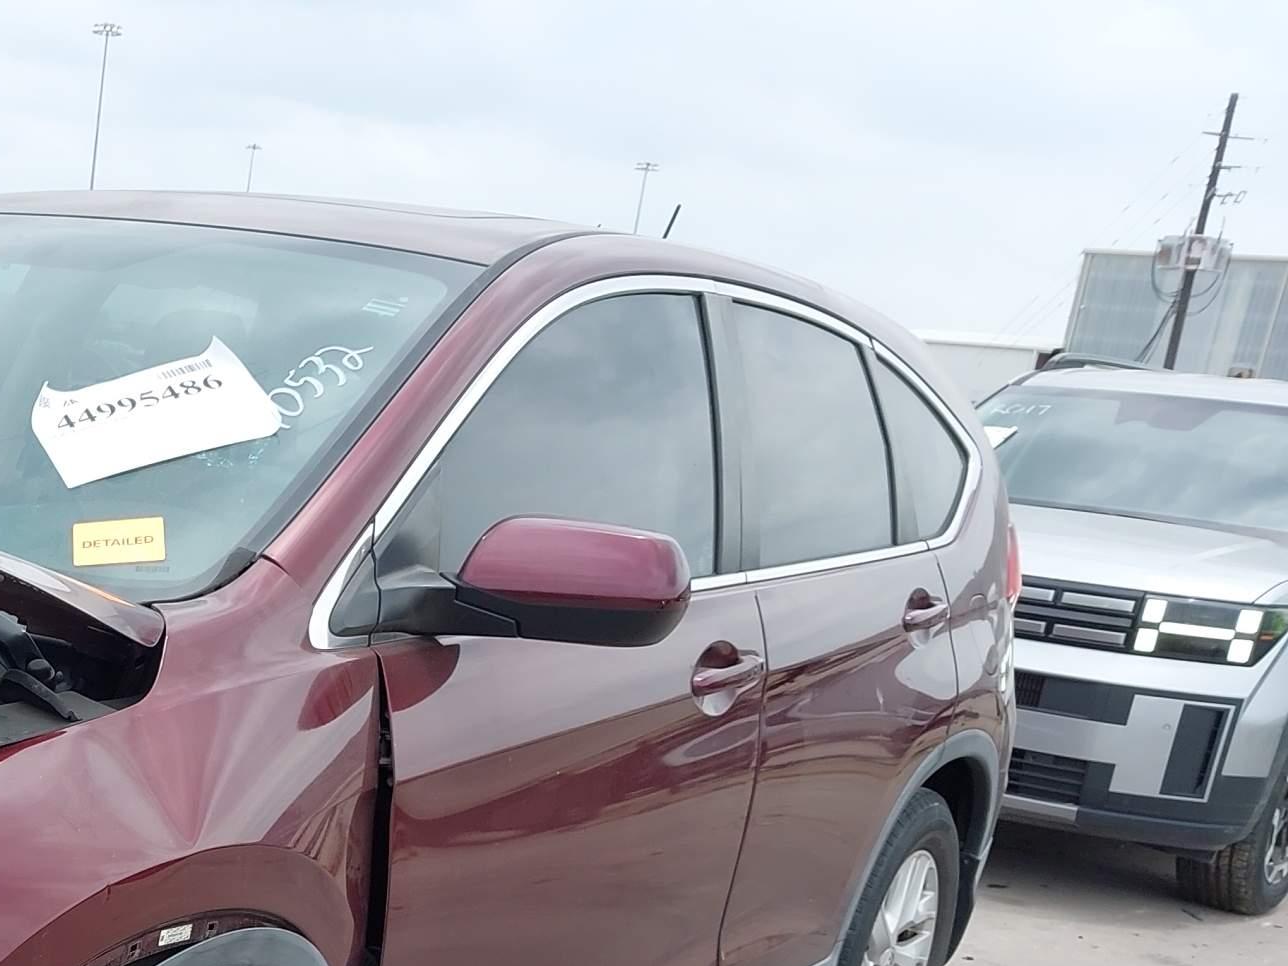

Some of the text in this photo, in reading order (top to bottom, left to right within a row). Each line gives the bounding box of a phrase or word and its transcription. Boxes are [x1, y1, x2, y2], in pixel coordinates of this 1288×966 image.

[57, 374, 223, 431] 44995486
[268, 345, 374, 429] 0532
[82, 535, 154, 549] DETAILED
